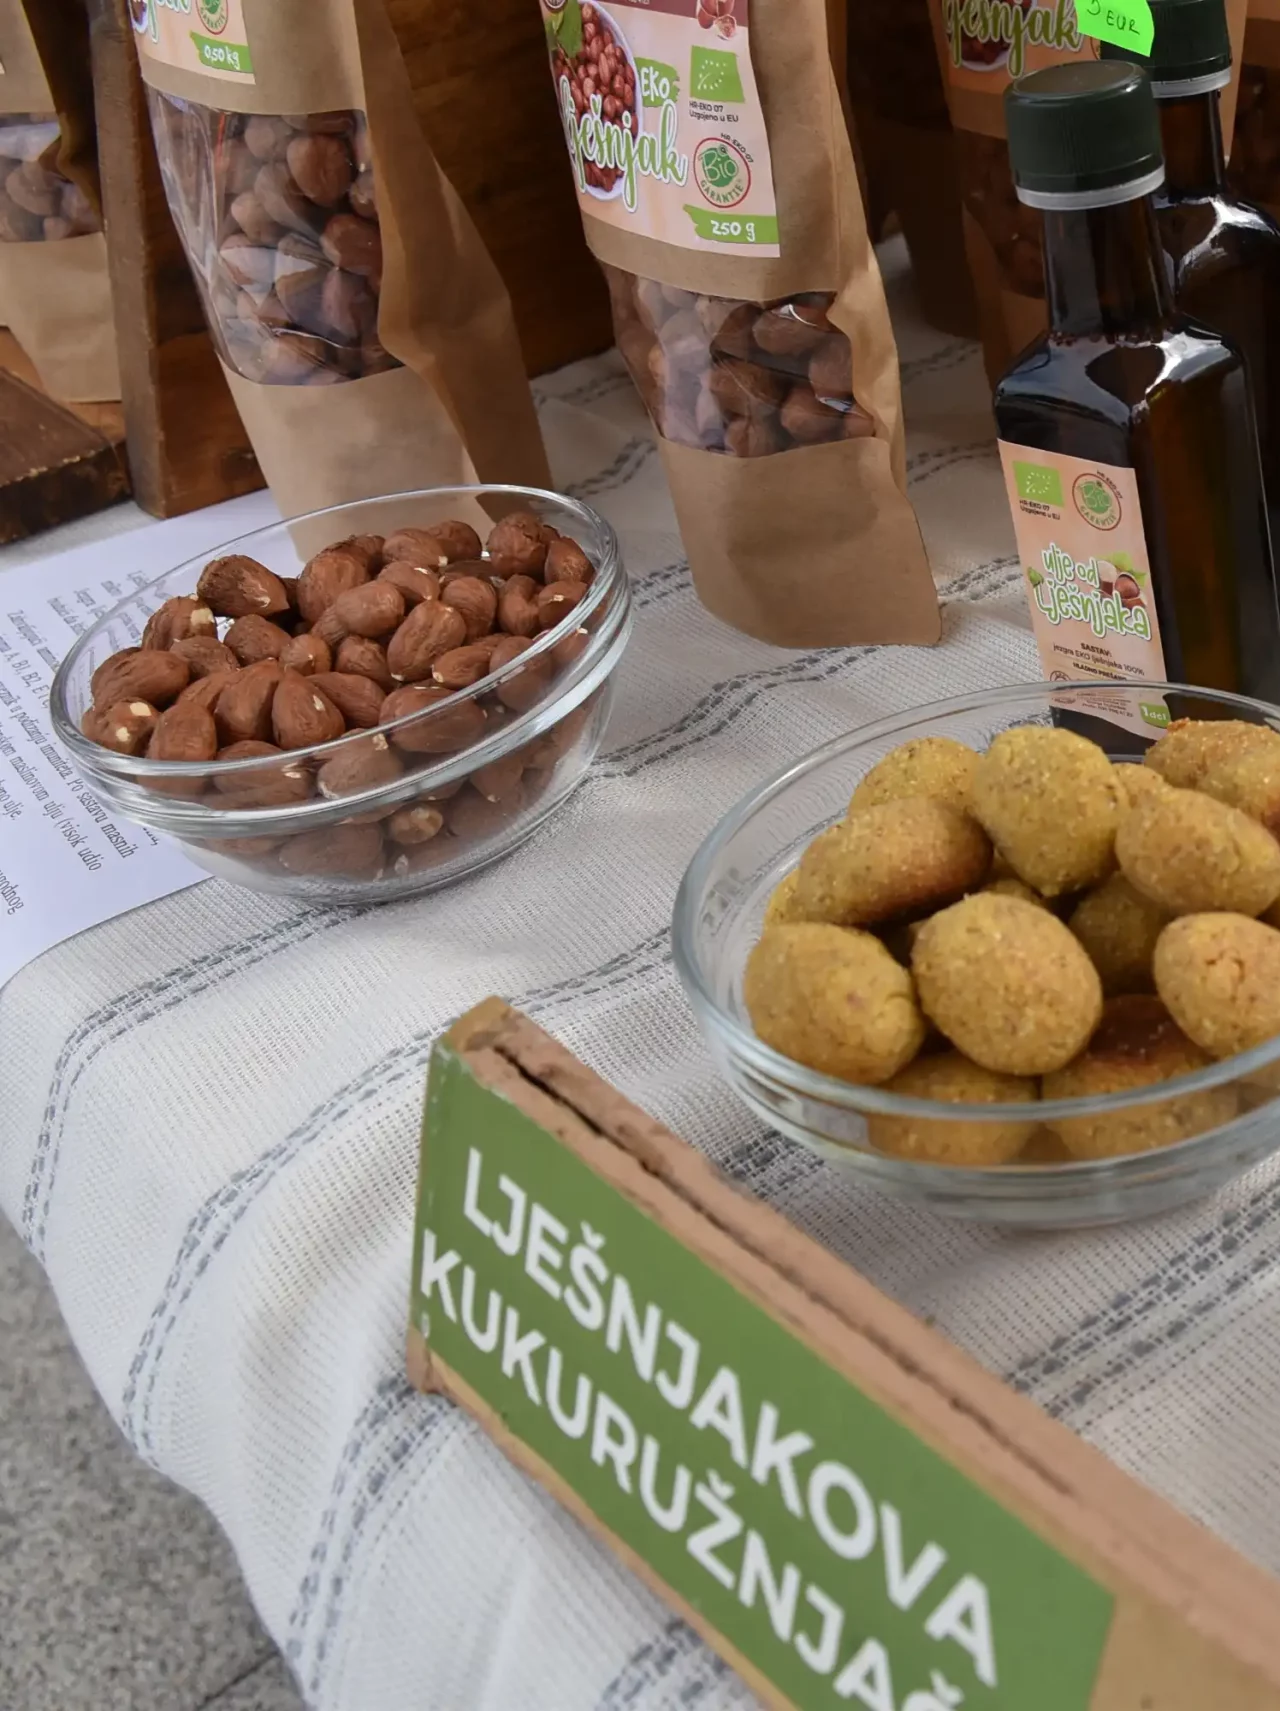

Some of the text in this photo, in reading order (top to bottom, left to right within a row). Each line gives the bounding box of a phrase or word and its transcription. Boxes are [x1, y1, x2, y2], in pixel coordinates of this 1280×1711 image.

[1106, 9, 1141, 36] EUR
[225, 46, 240, 70] kg
[640, 66, 670, 102] EKO
[689, 110, 719, 122] Uzgojeno
[726, 113, 739, 123] EU
[713, 105, 724, 113] 07
[699, 179, 746, 204] GARANTIE
[710, 219, 756, 242] 250 g
[1042, 542, 1100, 588] ulje od
[1034, 577, 1152, 641] Lješnjaka
[9, 755, 50, 801] maslinovom
[42, 800, 67, 820] ulju
[67, 778, 84, 792] Po
[76, 791, 108, 823] sastavu
[100, 822, 139, 859] masnih
[53, 816, 89, 848] (visok
[77, 847, 105, 871] udio
[463, 1146, 999, 1689] LJEŠNJAKOVA
